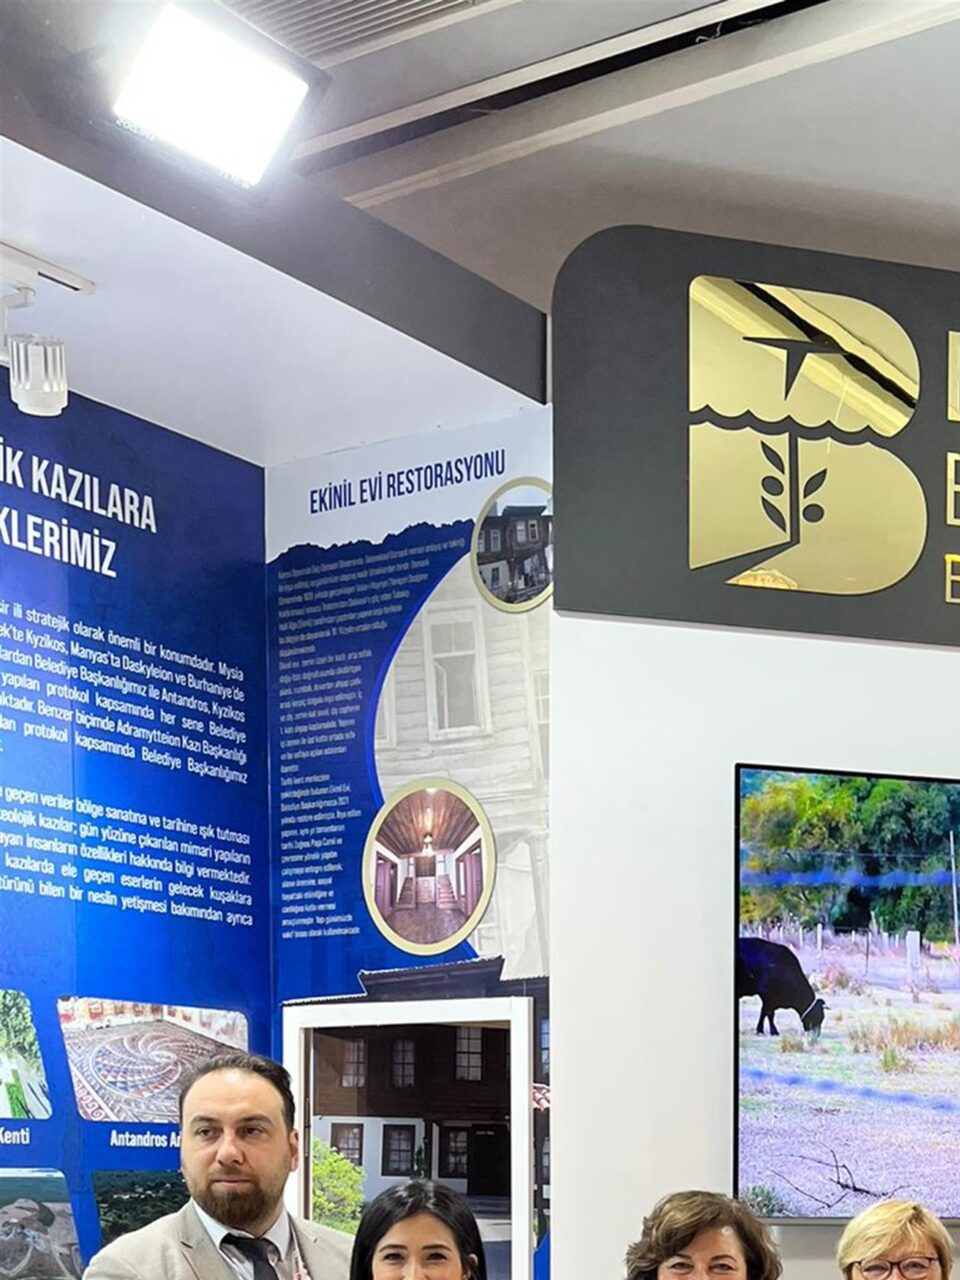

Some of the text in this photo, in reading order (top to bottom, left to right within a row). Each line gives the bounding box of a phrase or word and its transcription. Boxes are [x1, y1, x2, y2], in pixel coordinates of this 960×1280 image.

[32, 455, 158, 534] KAZILARA
[310, 449, 505, 514] EKİNİL EVİ RESTORASYONU
[26, 610, 71, 631] stratejik
[73, 622, 106, 640] olarak
[107, 631, 142, 650] önemli
[143, 640, 158, 655] bir
[159, 646, 217, 671] konumdadır.
[218, 662, 245, 680] Mysia
[26, 630, 69, 653] Kyzikos,
[70, 642, 121, 666] Manyas'ta
[122, 656, 174, 680] Daskyleion
[175, 673, 187, 685] ve
[187, 674, 246, 700] Burhaniye'de
[2, 673, 247, 743] yapılan protokol kapsamında her sene Belediye
[34, 654, 79, 678] Belediye
[79, 667, 148, 695] Başkanlığımız
[148, 684, 160, 699] ile
[161, 689, 211, 712] Antandros,
[212, 702, 246, 721] Kyzikos
[23, 723, 69, 741] protokol
[75, 732, 136, 756] kapsamında
[141, 747, 182, 768] Belediye
[187, 758, 248, 782] Başkanlığımız
[37, 700, 74, 720] Benzer
[75, 710, 116, 730] biçimde
[116, 721, 181, 745] Adramytteion
[182, 736, 202, 751] Kazı
[202, 741, 248, 764] Başkanlığı
[0, 809, 37, 826] eolojik
[79, 822, 100, 837] gün
[101, 827, 138, 843] yüzüne
[180, 842, 213, 857] mimari
[5, 788, 39, 803] geçen
[40, 794, 75, 809] veriler
[76, 798, 105, 817] bölge
[105, 808, 148, 824] sanatına
[148, 816, 161, 827] ve
[162, 817, 199, 834] tarihine
[216, 828, 251, 843] tutması
[5, 854, 253, 904] kazılarda ele geçen eserlerin gelecek kuşaklara
[129, 853, 173, 871] hakkında
[174, 860, 195, 877] bilgi
[39, 882, 66, 896] bilen
[69, 885, 84, 900] bir
[87, 891, 119, 904] neslin
[121, 897, 169, 912] yetişmesi
[110, 1130, 168, 1147] Antandros
